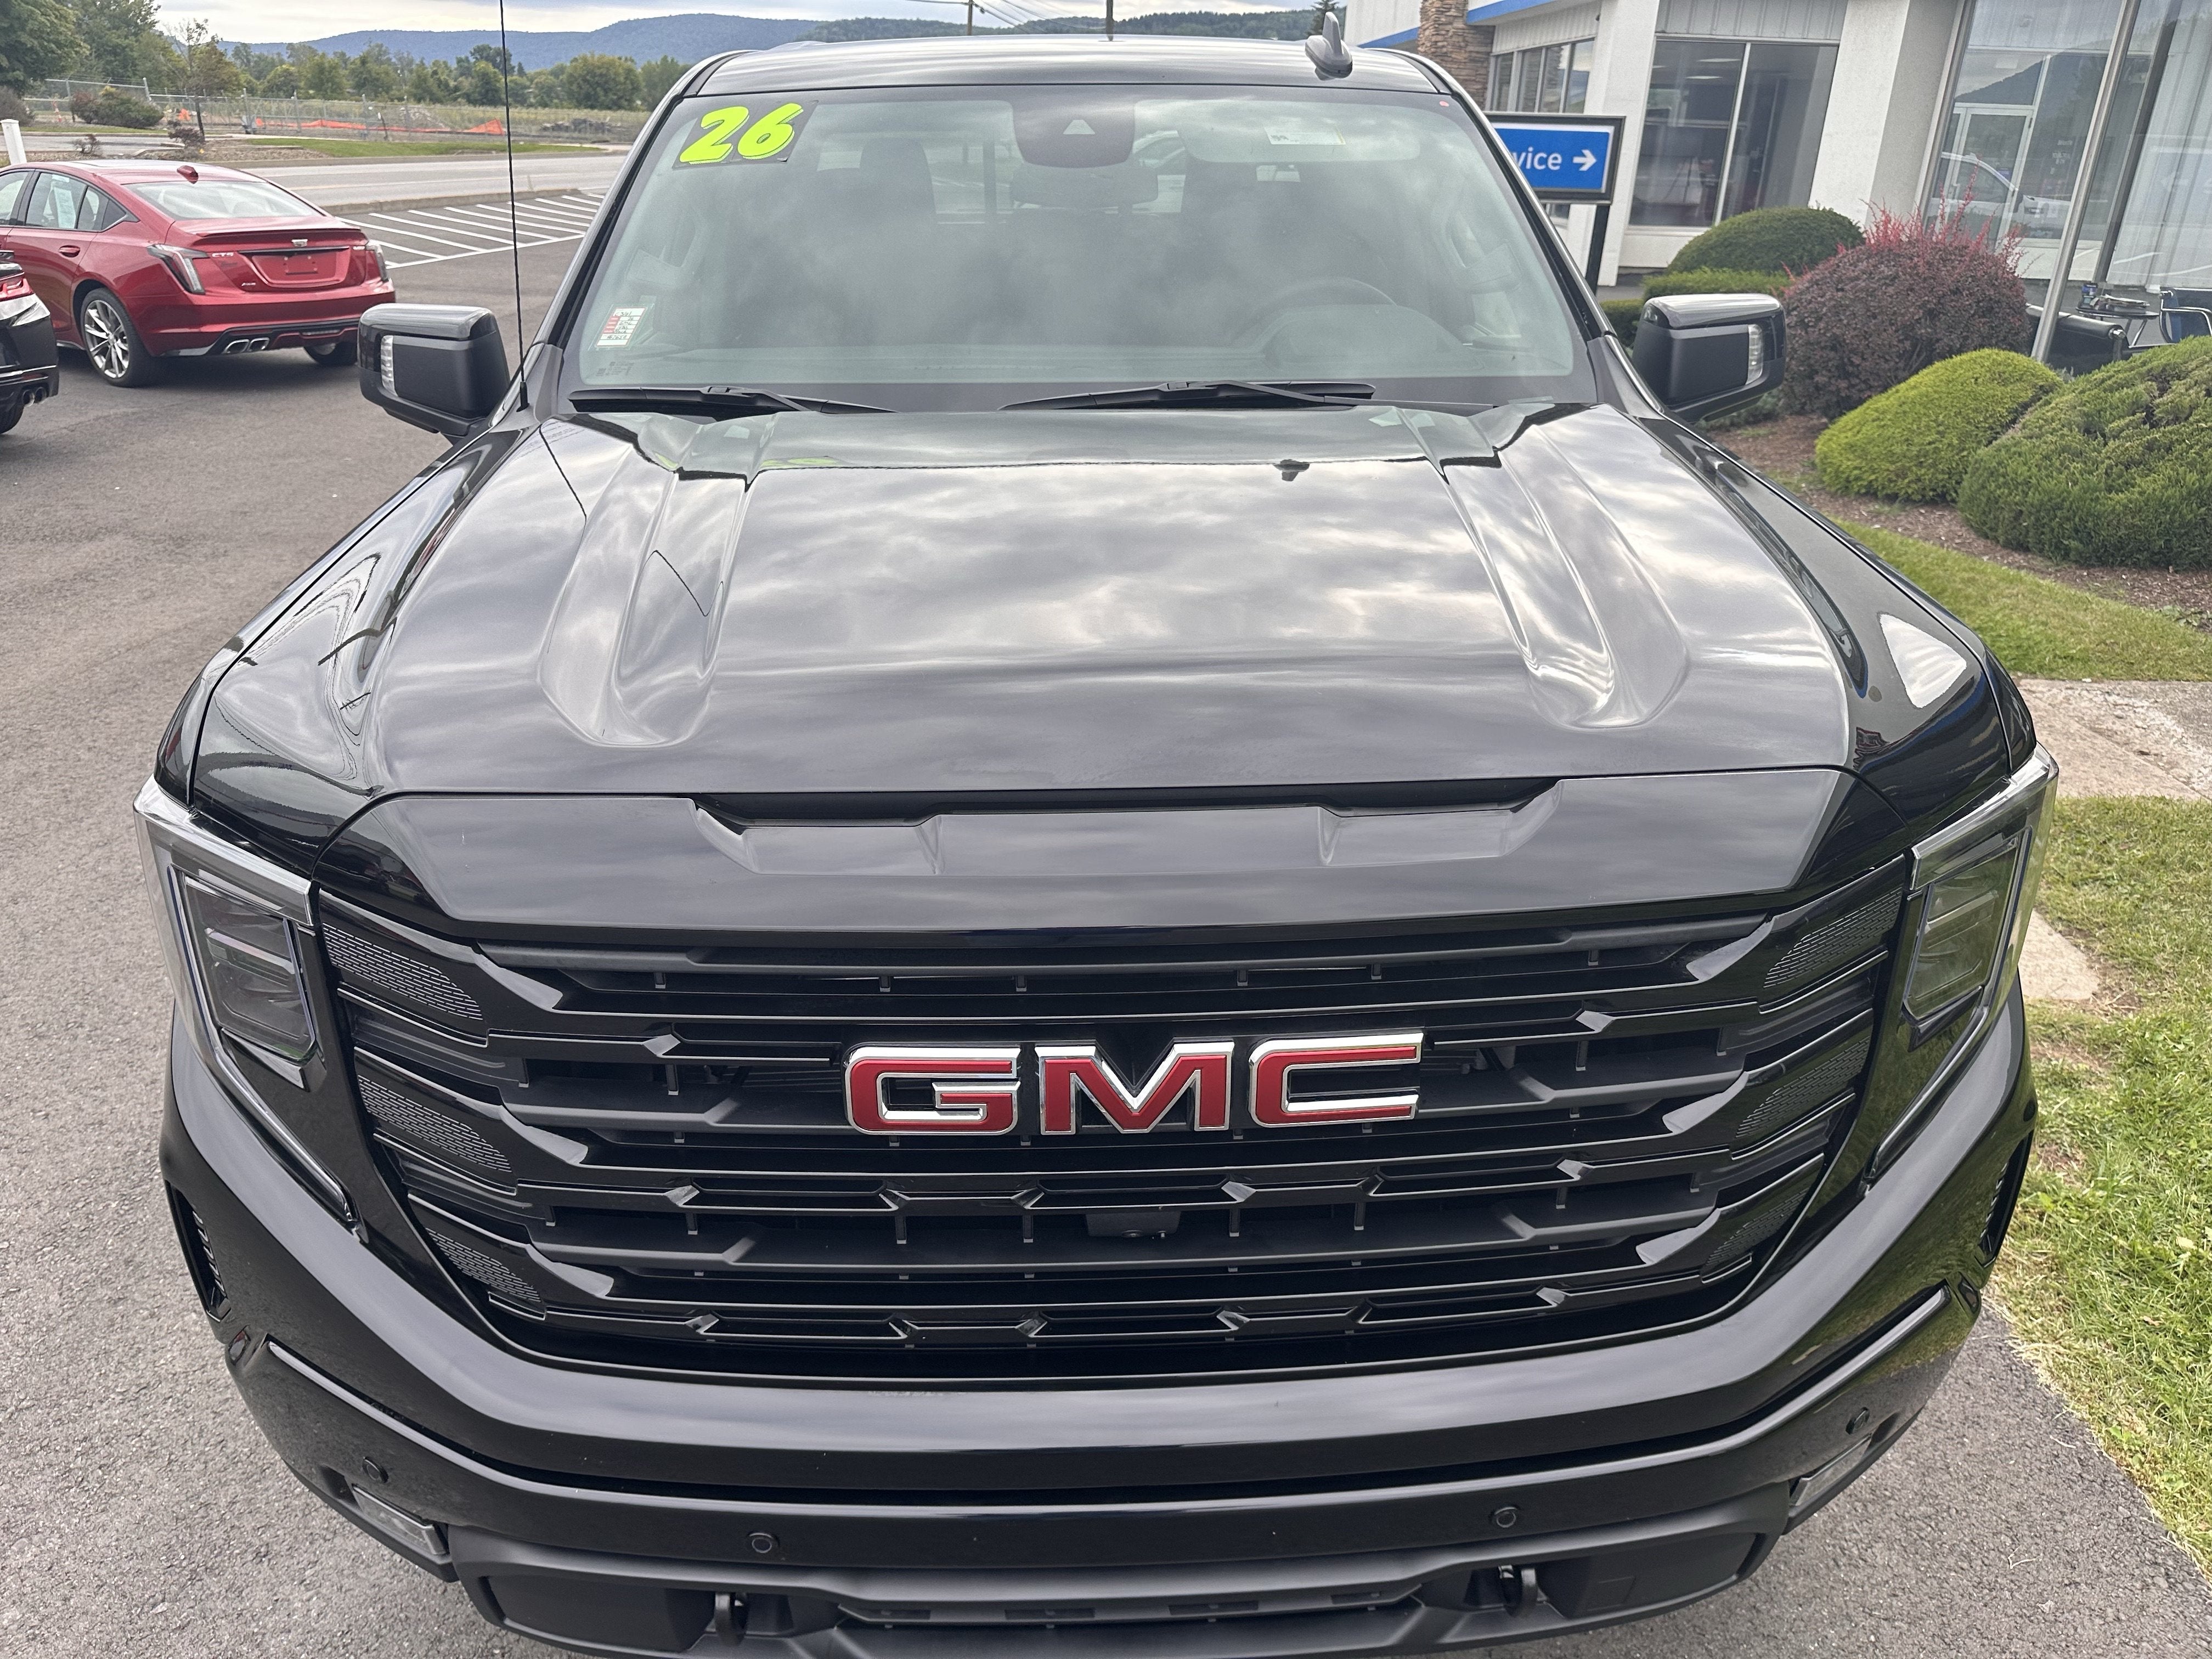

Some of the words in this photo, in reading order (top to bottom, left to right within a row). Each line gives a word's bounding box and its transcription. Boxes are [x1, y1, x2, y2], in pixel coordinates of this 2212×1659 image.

[680, 103, 804, 165] 26
[1512, 146, 1562, 171] vice
[845, 1032, 1424, 1136] GMC
